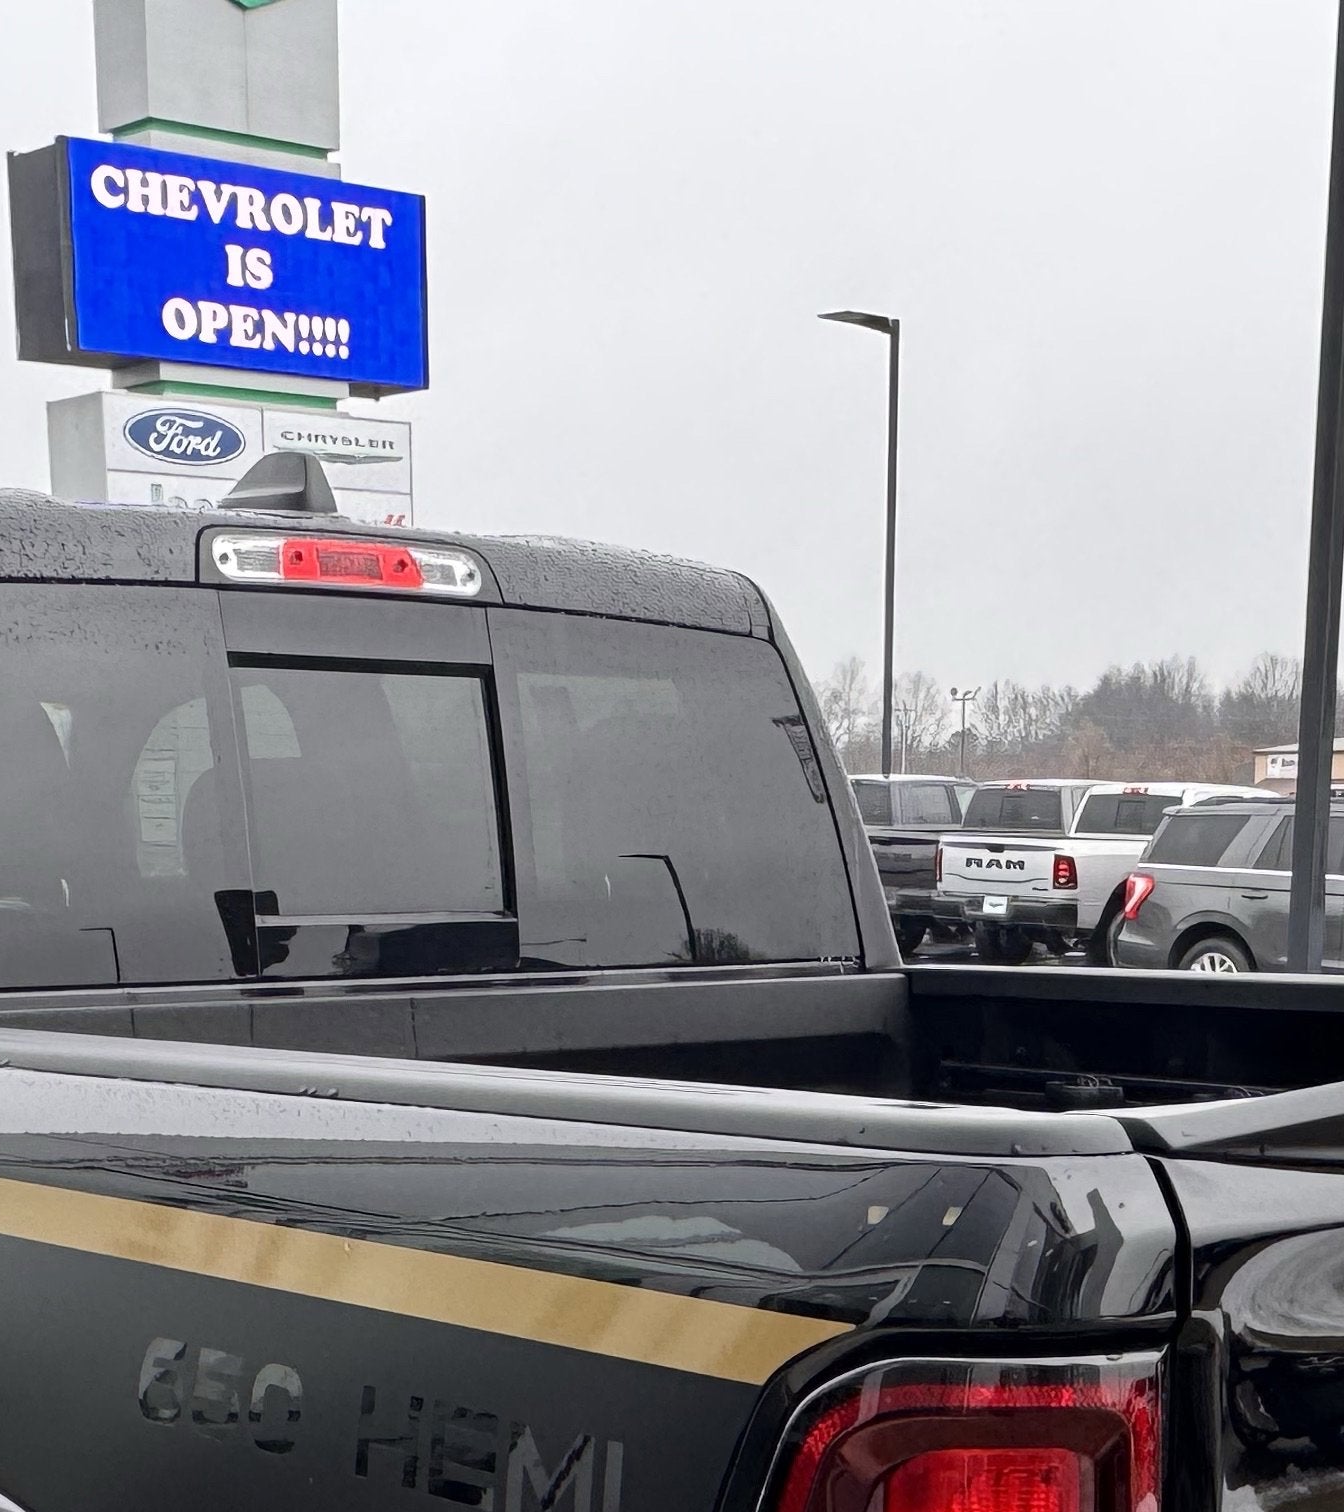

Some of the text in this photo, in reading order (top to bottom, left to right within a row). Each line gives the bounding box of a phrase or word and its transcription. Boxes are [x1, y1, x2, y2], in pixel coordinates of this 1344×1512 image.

[90, 164, 394, 250] CHEVROLET
[225, 243, 274, 290] IS
[161, 298, 351, 360] OPEN!!!!
[148, 415, 223, 458] Ford
[280, 430, 396, 450] CHRYSLER
[138, 1336, 304, 1454] 650
